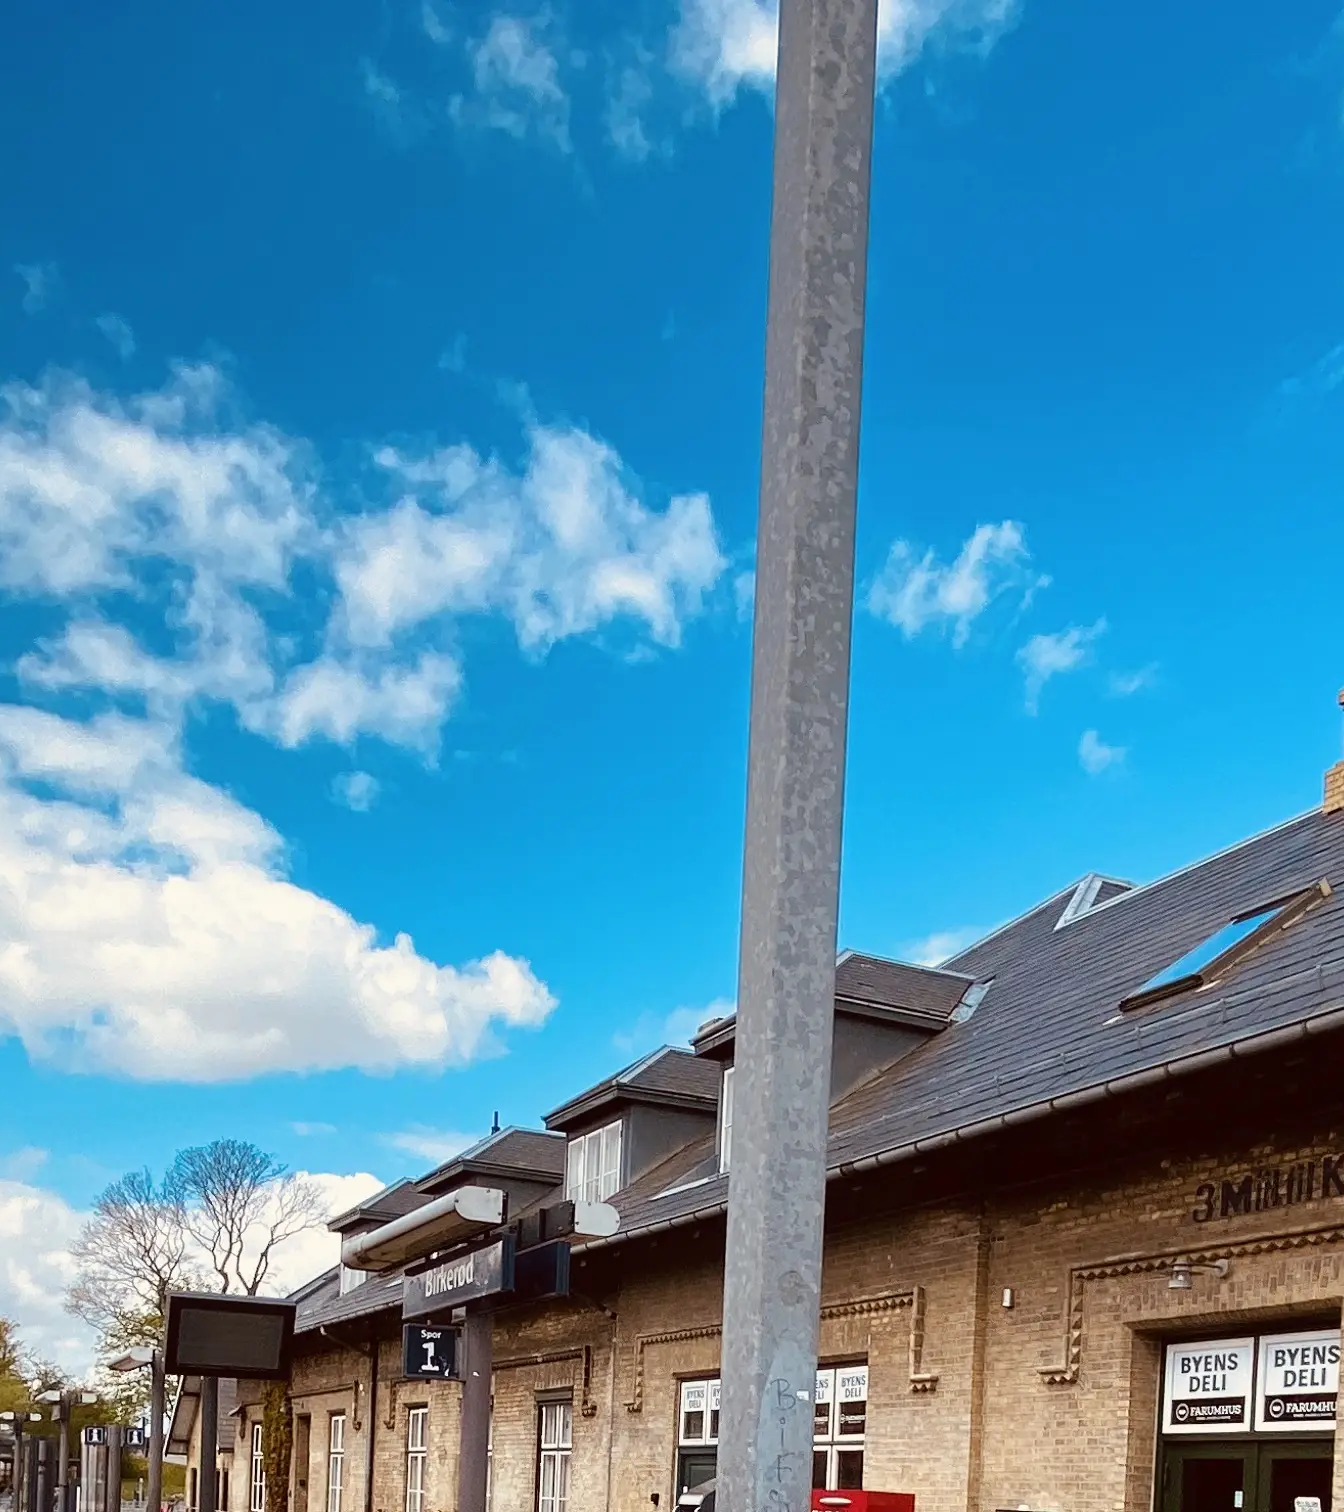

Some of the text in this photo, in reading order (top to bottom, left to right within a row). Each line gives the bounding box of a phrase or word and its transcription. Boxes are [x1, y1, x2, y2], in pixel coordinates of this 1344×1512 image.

[1193, 1182, 1216, 1223] 3
[425, 1252, 475, 1298] Birkerød
[420, 1329, 442, 1339] Spor
[421, 1341, 440, 1371] 1
[1181, 1353, 1239, 1374] BYENS
[1273, 1344, 1342, 1368] BYENS
[841, 1374, 866, 1388] BYENS
[1189, 1374, 1227, 1393] DELI
[1283, 1367, 1327, 1388] DELI
[844, 1387, 862, 1399] DELI
[1190, 1404, 1242, 1416] FARUMHUS
[1286, 1401, 1337, 1413] FARUMHU
